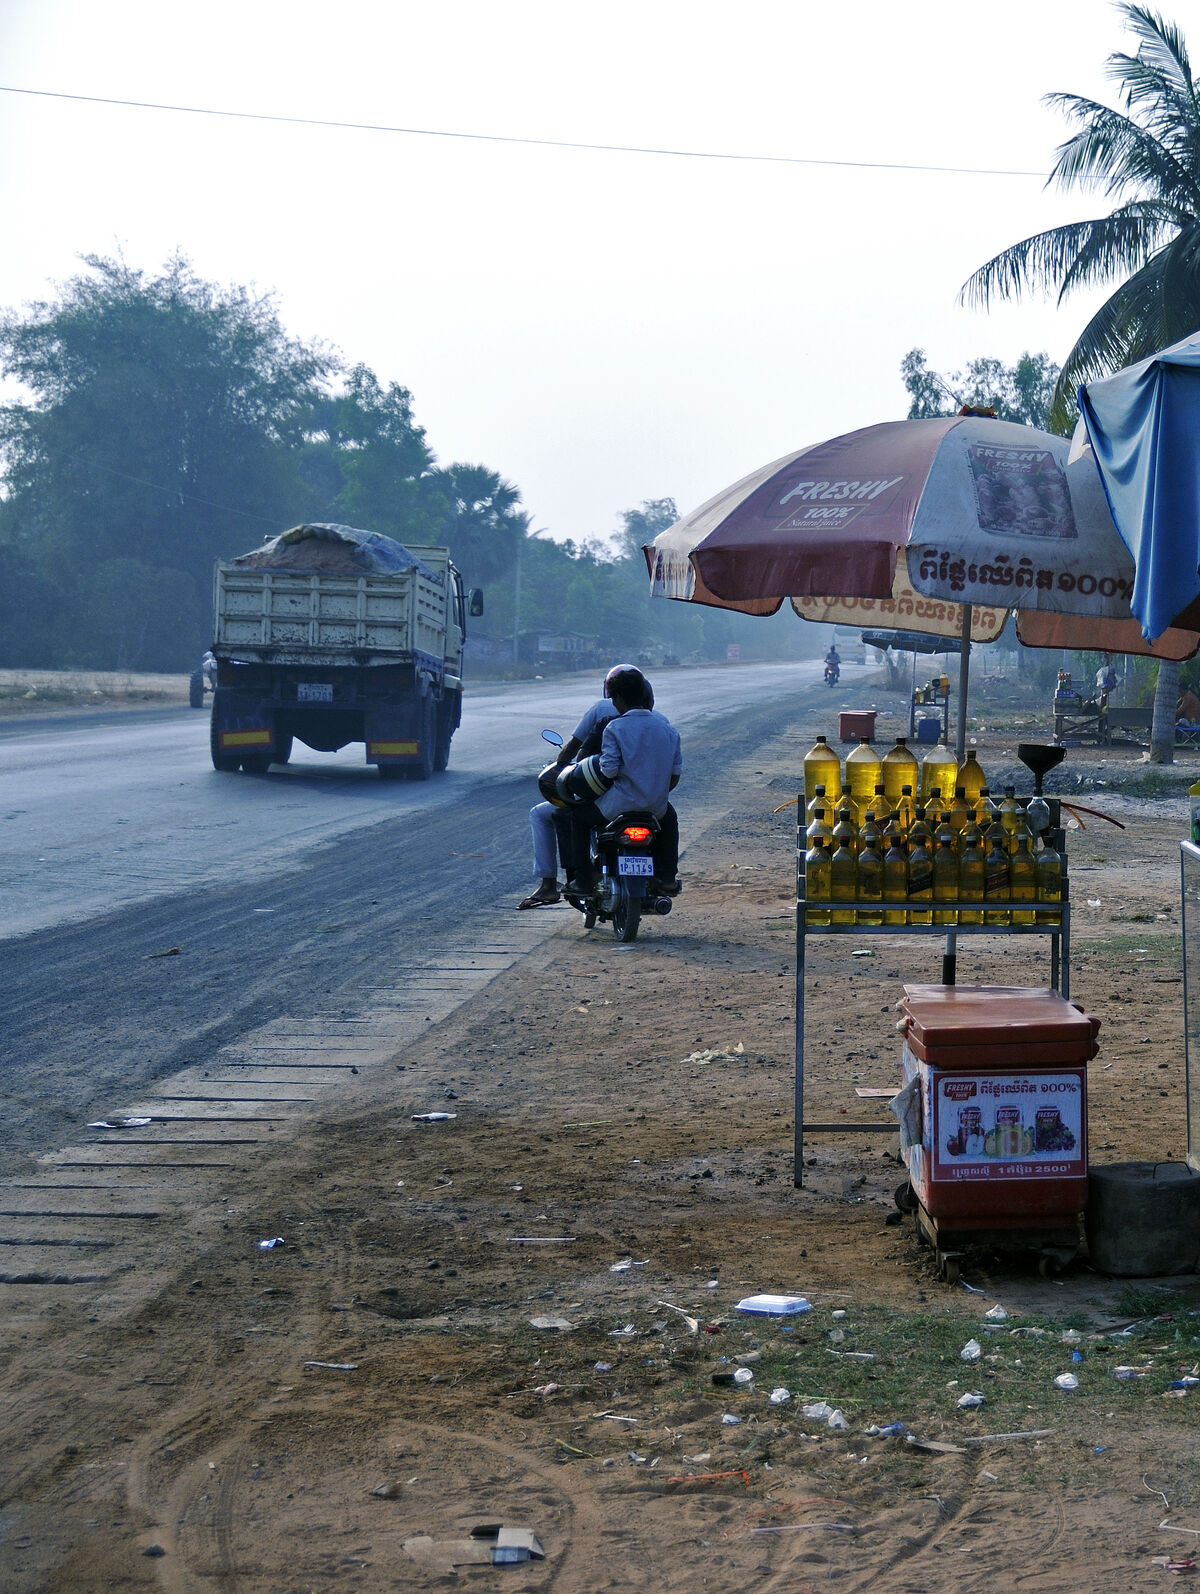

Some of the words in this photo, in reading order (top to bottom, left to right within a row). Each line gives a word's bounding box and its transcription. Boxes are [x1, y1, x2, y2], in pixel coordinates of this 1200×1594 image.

[976, 447, 1049, 463] FRESHY
[779, 476, 904, 505] FRESHY
[803, 506, 855, 519] 100%
[788, 518, 822, 527] Natural
[946, 1083, 975, 1093] FRESHY
